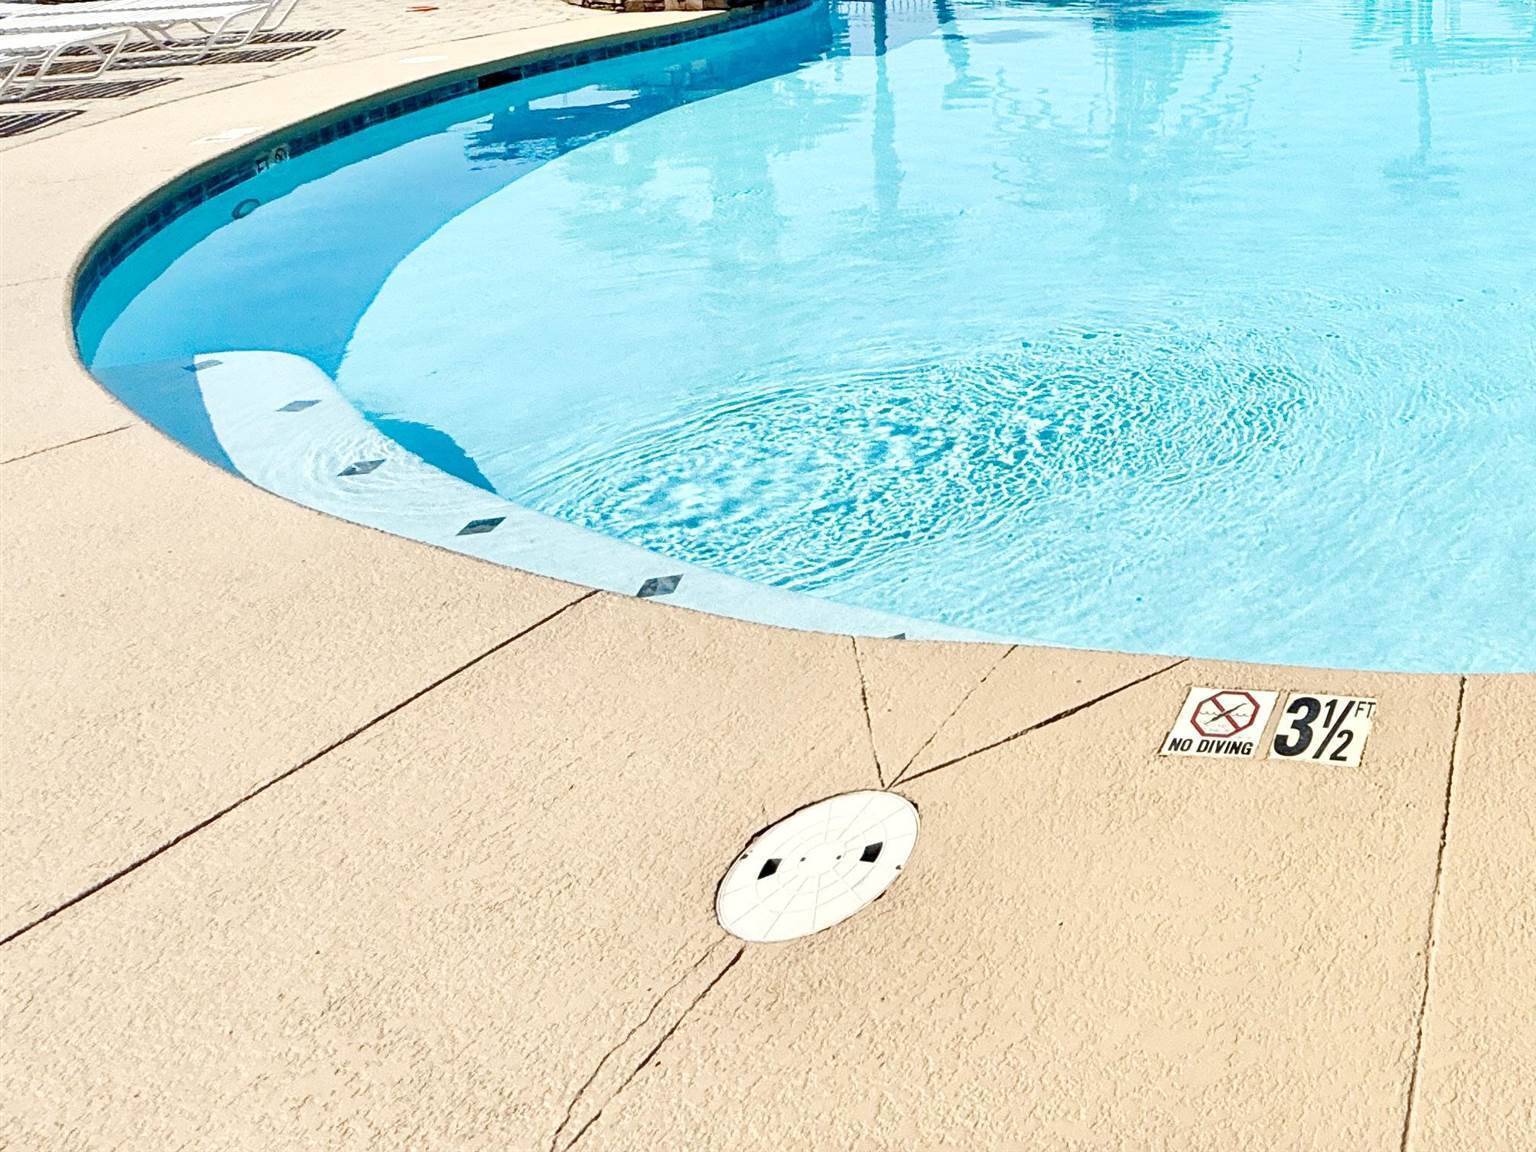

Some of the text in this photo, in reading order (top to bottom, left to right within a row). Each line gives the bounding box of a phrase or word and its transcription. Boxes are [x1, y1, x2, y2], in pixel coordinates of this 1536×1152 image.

[1355, 701, 1376, 718] FT
[1168, 738, 1254, 756] NO DIVING
